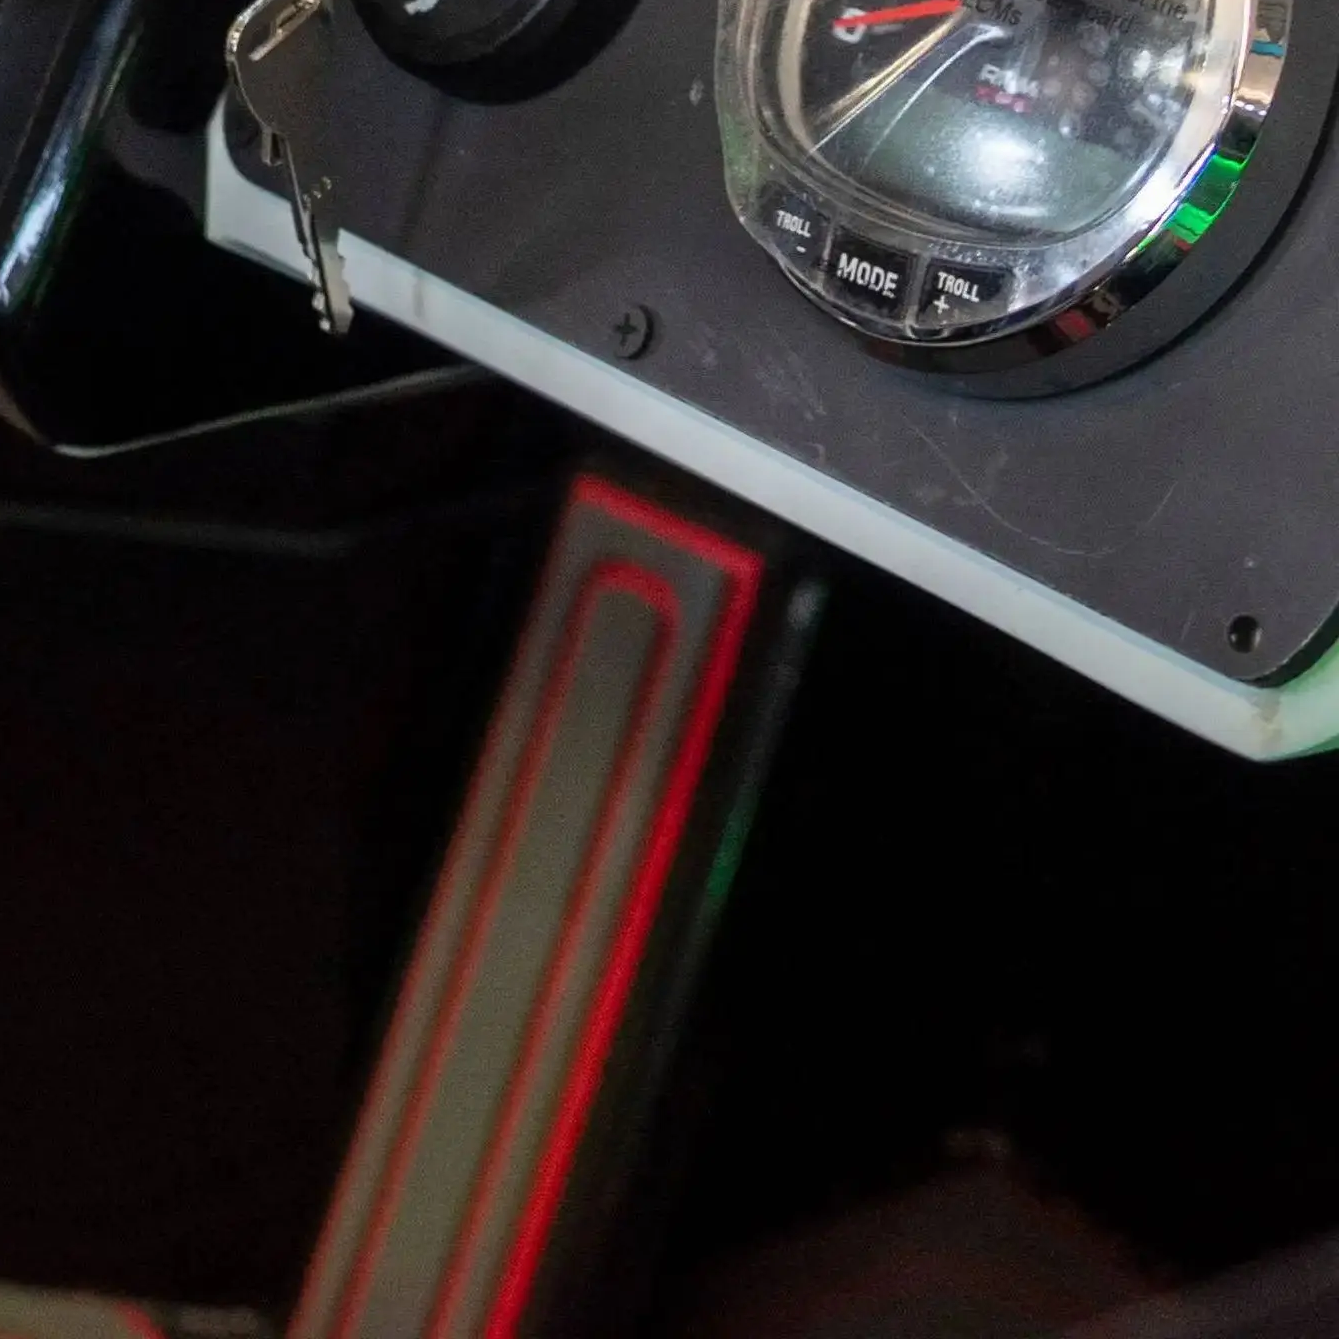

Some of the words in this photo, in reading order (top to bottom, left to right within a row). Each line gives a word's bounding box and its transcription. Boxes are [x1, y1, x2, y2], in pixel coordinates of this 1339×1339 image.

[776, 209, 812, 238] TROLL
[836, 251, 900, 299] MODE
[937, 270, 981, 303] TROLL
